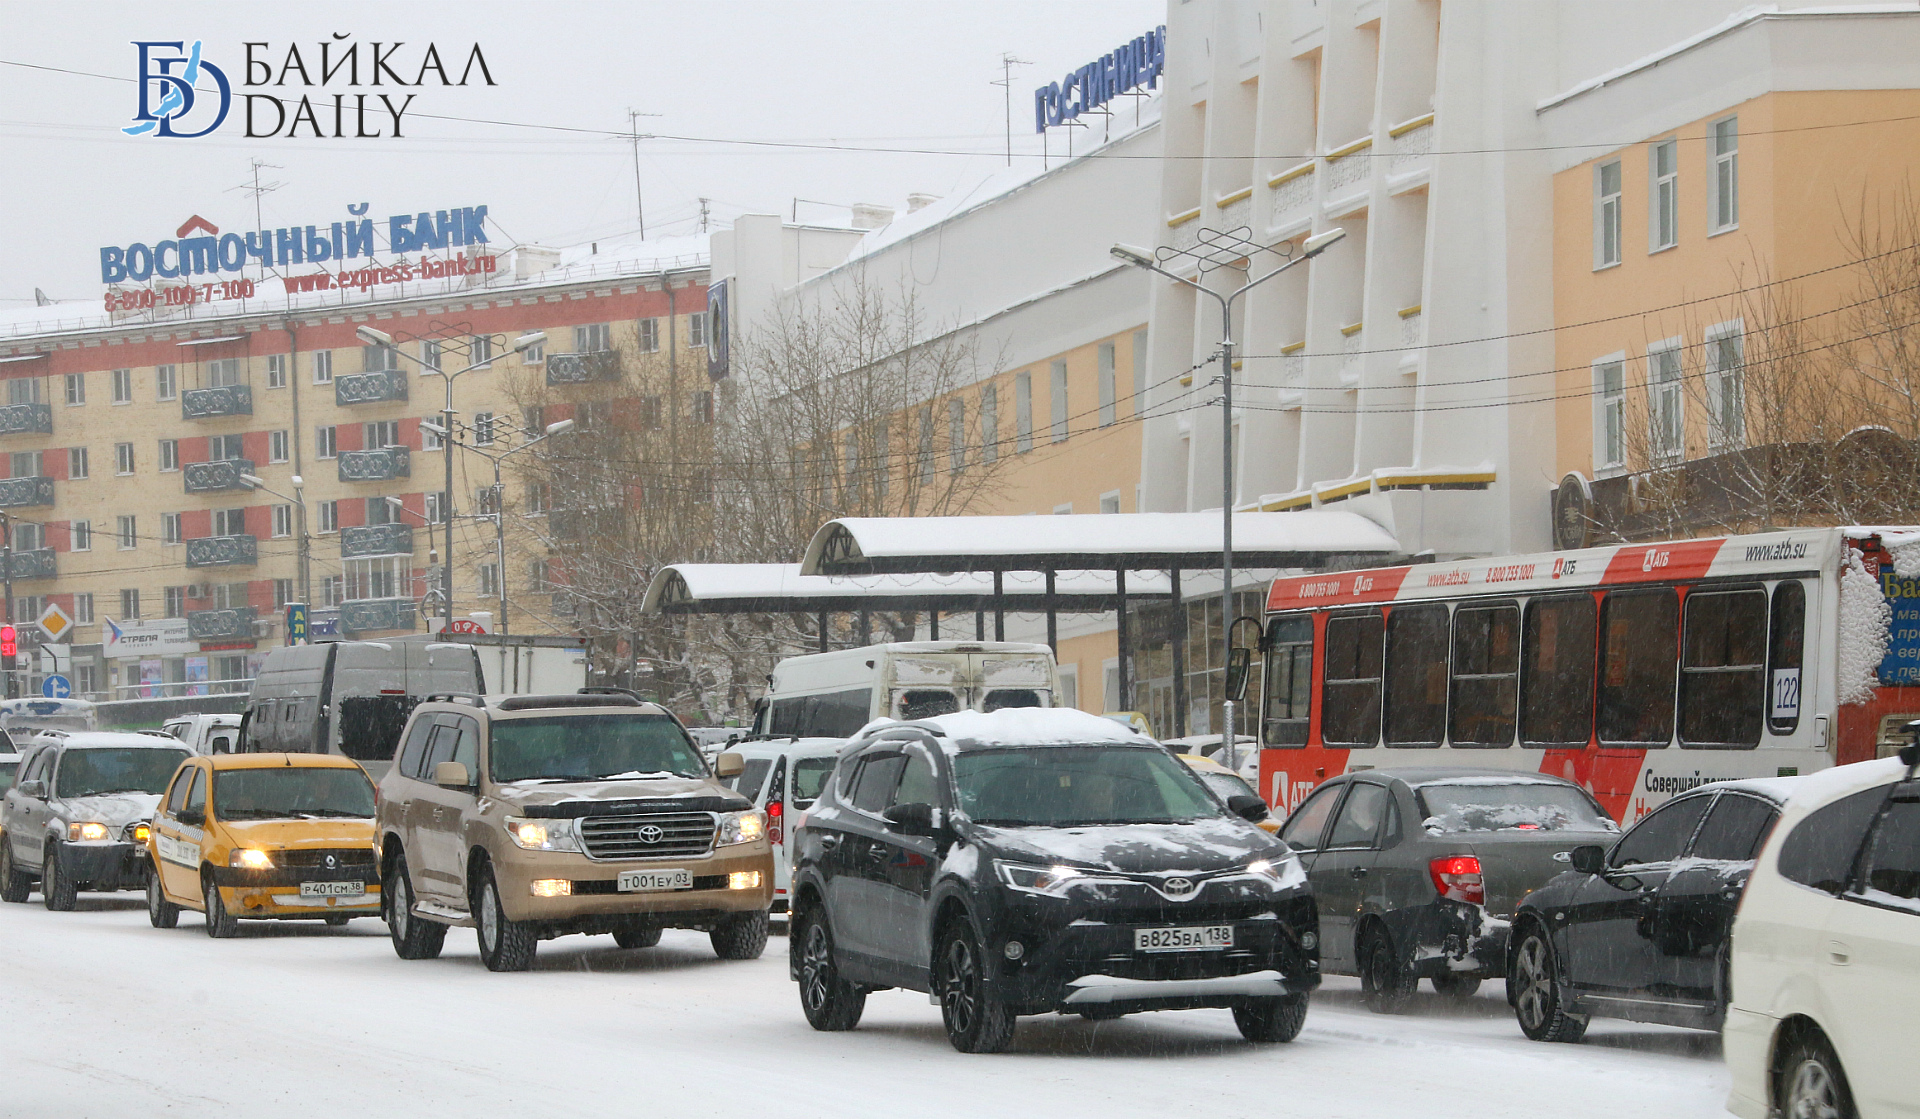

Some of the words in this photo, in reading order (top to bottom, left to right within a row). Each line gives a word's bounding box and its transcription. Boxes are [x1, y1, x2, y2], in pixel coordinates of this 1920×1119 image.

[1035, 25, 1166, 134] ГОСТИНИЦА
[100, 202, 374, 284] ВОСТОЧНЫЙ
[389, 205, 492, 254] БАНК
[283, 252, 496, 294] www.express-bank.ru
[104, 278, 255, 313] 8-800-100-7-100
[1745, 537, 1808, 561] www.atb.su
[1561, 560, 1578, 576] АТБ
[1653, 552, 1670, 567] АТБ
[1427, 567, 1470, 587] www.atb.su
[1485, 567, 1493, 583] 8
[1491, 566, 1506, 582] 800
[1505, 565, 1520, 581] 755
[1518, 563, 1535, 581] 1001
[450, 622, 480, 633] ОФЕ
[120, 634, 158, 643] СТРЕЛА
[1776, 677, 1797, 709] 122
[1645, 768, 1700, 798] Совершай
[304, 883, 348, 895] Р401СМ
[350, 882, 361, 891] 38
[623, 875, 672, 889] Т001ЕУ
[675, 873, 688, 883] 03
[1140, 930, 1203, 948] В825ВА
[1205, 927, 1230, 941] 138
